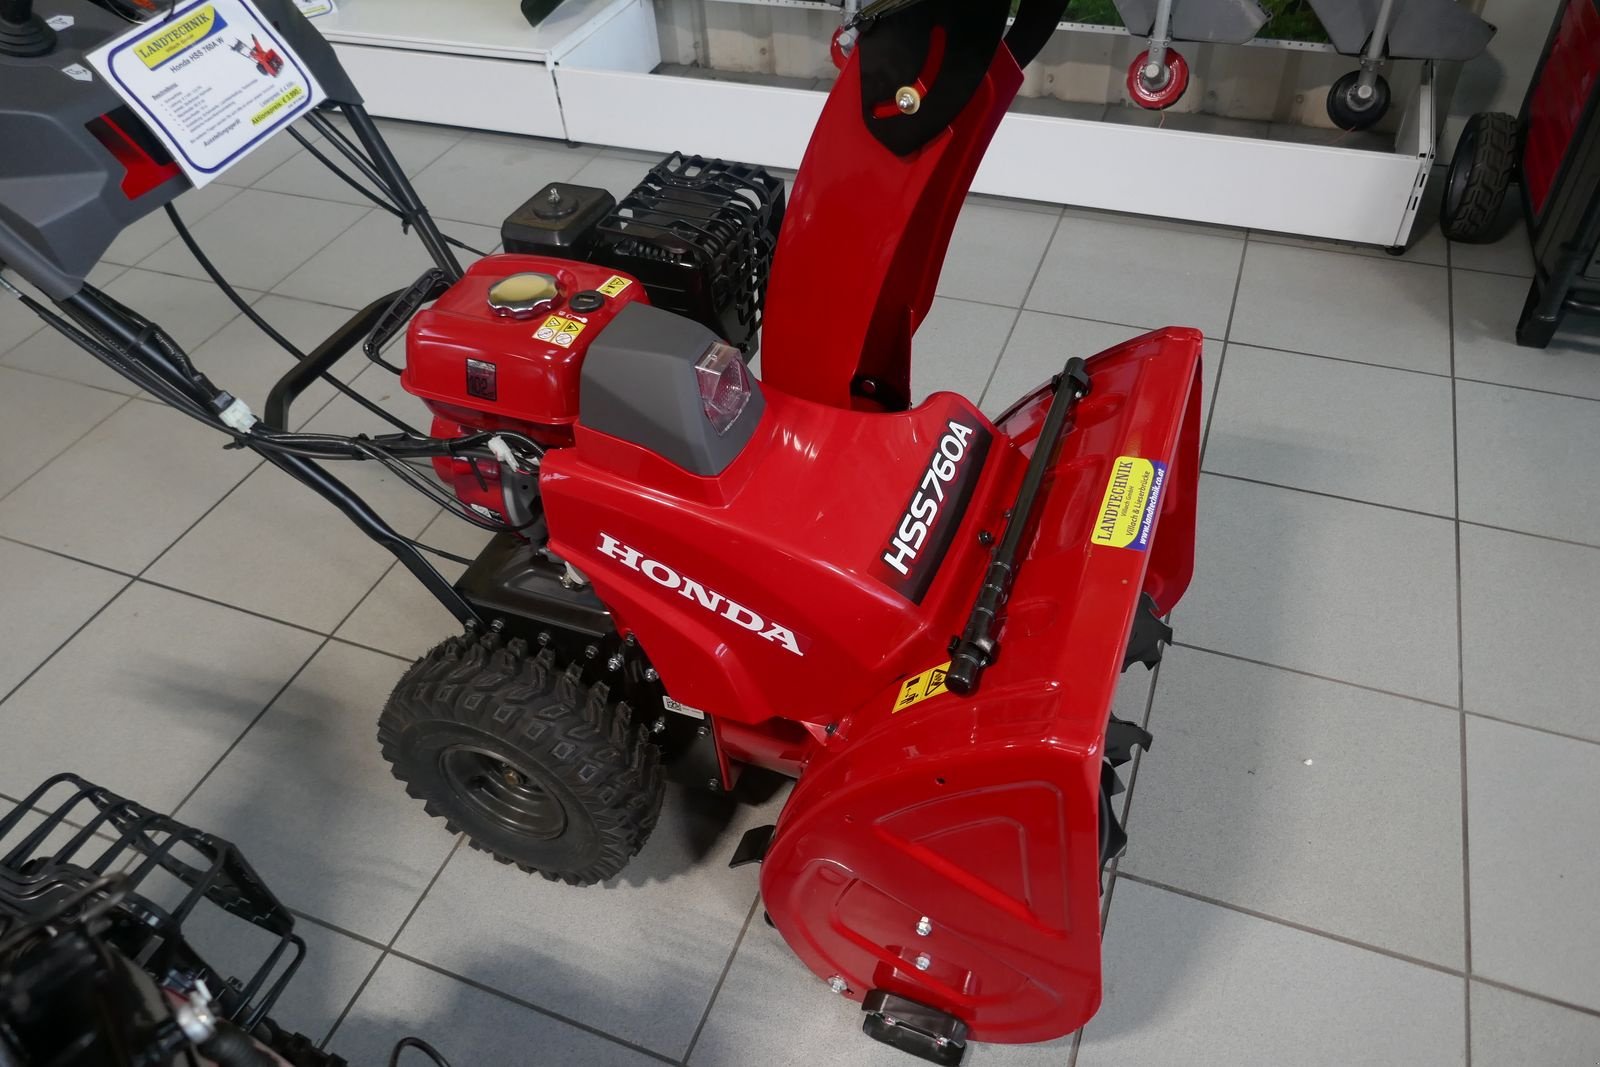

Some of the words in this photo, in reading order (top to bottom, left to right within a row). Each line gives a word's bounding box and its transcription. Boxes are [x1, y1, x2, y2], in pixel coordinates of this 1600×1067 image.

[138, 12, 210, 58] LANDTECHNIK
[169, 57, 191, 73] Honda
[189, 49, 204, 62] HSS
[217, 36, 225, 45] W
[883, 421, 973, 575] HSS760A
[1097, 461, 1133, 541] LANDTECHNIK
[1121, 500, 1130, 517] Villach
[1126, 486, 1134, 501] GmbH
[1126, 514, 1138, 536] Villach
[1136, 471, 1151, 508] Lieserbrücke
[1139, 468, 1165, 545] www.landtechnik.co.at
[597, 532, 804, 656] HONDA
